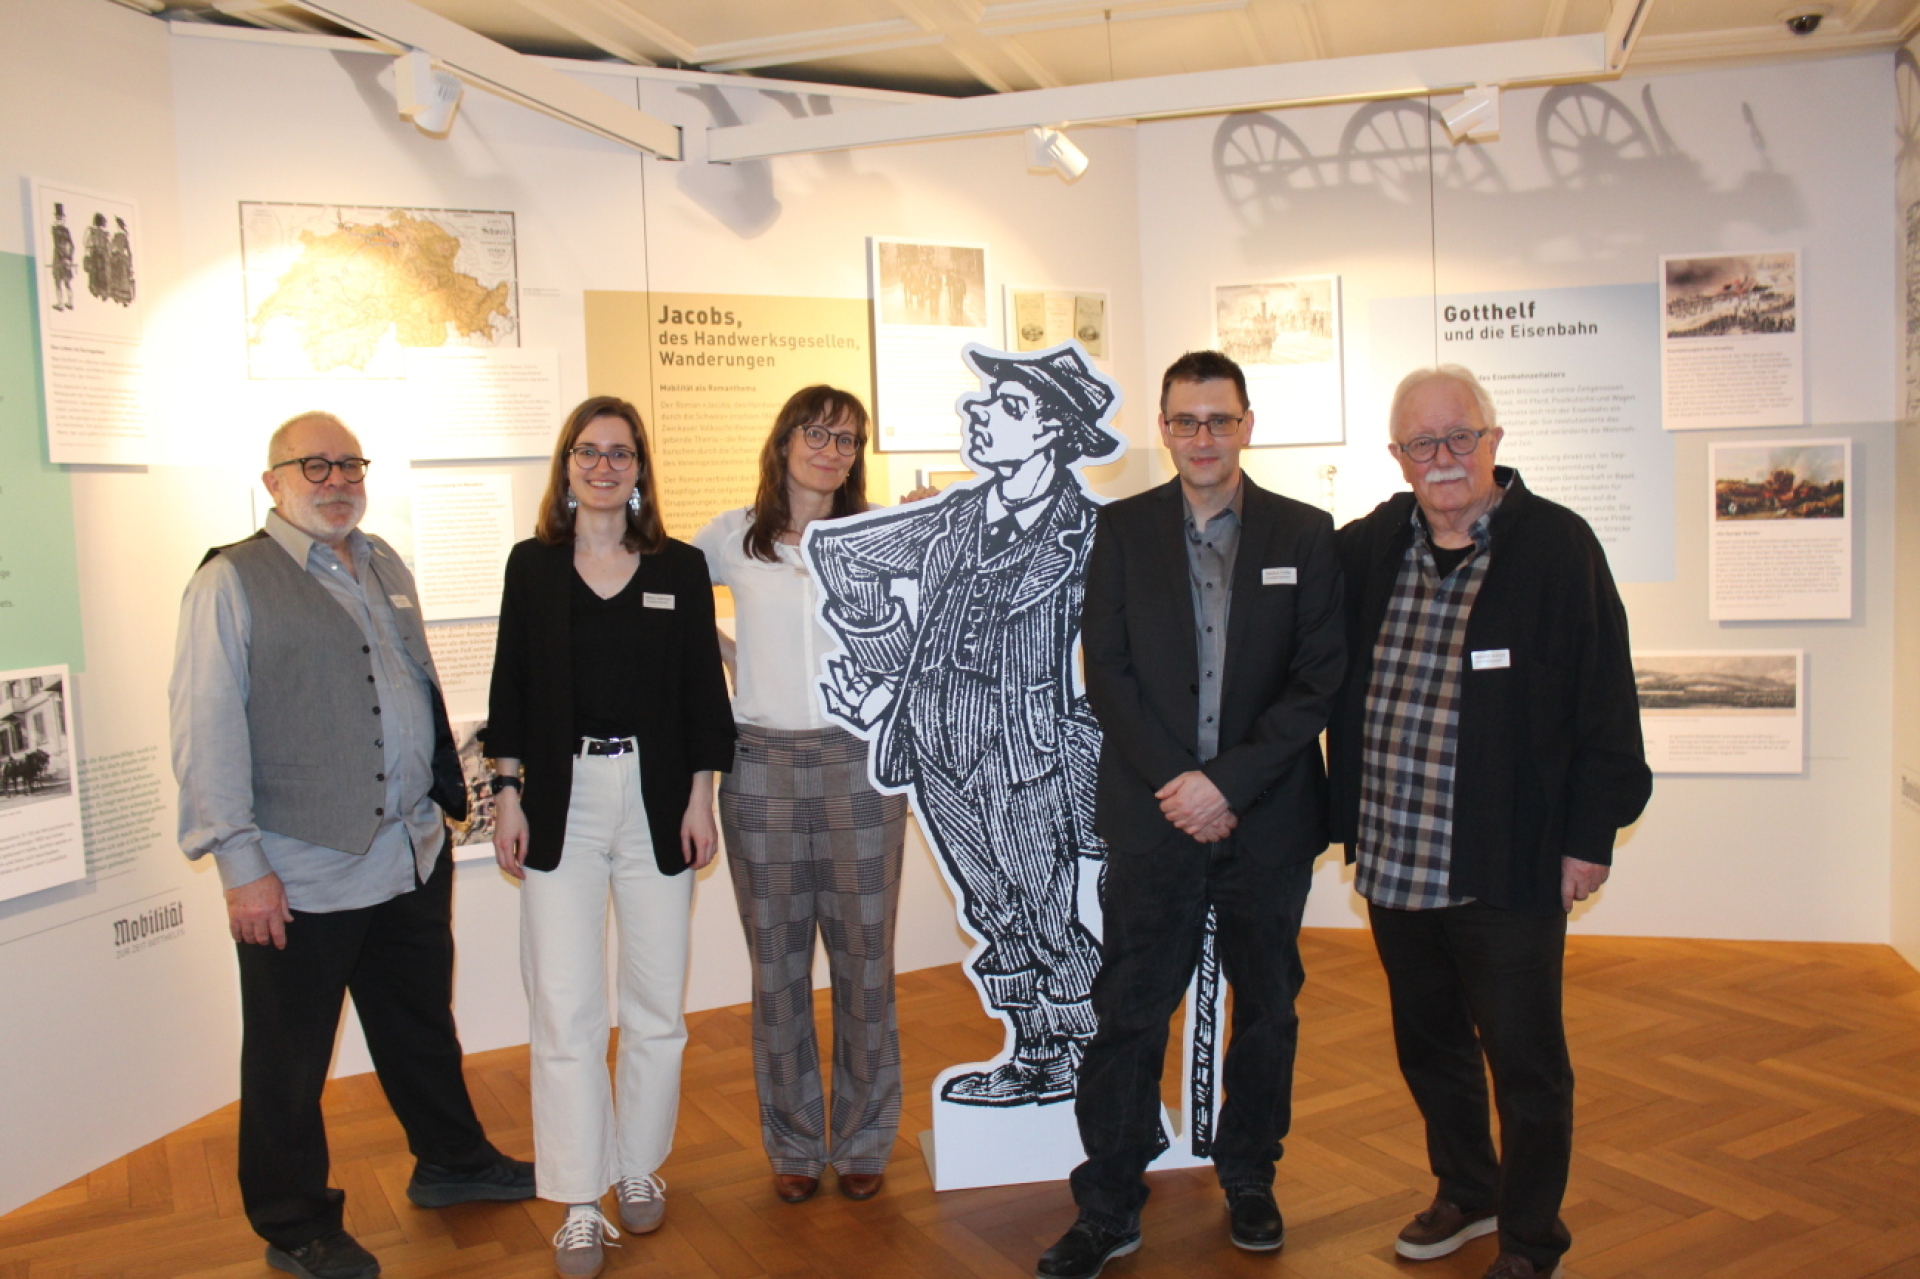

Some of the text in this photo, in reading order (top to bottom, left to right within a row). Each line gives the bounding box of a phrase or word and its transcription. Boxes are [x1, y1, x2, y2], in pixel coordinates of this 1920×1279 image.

[658, 305, 742, 328] Jacobs,
[1444, 301, 1535, 323] Gotthelf
[1445, 321, 1598, 341] und die Eisenbahn
[659, 330, 860, 350] des Handwerksgesellen,
[659, 351, 775, 370] Wanderungen
[1492, 371, 1566, 380] Eisenbahnzeitalters
[659, 384, 756, 392] Mobilität als Romanthema
[1557, 386, 1574, 394] seine
[1577, 384, 1624, 393] Zeitgenossen
[1552, 396, 1594, 404] Postkutsche
[1611, 394, 1635, 403] Wagen
[660, 401, 673, 409] Der
[675, 401, 700, 409] Roman
[734, 401, 747, 409] des
[1554, 416, 1604, 425] revolutionierte
[1536, 428, 1549, 436] und
[1551, 427, 1588, 435] veränderte
[661, 436, 692, 444] gebende
[697, 447, 717, 455] durch
[1546, 463, 1594, 471] Versammlung
[705, 475, 737, 483] verbindet
[1562, 472, 1605, 481] Gesellschaft
[664, 487, 701, 496] Hauptfigur
[113, 900, 183, 947] Mobilität
